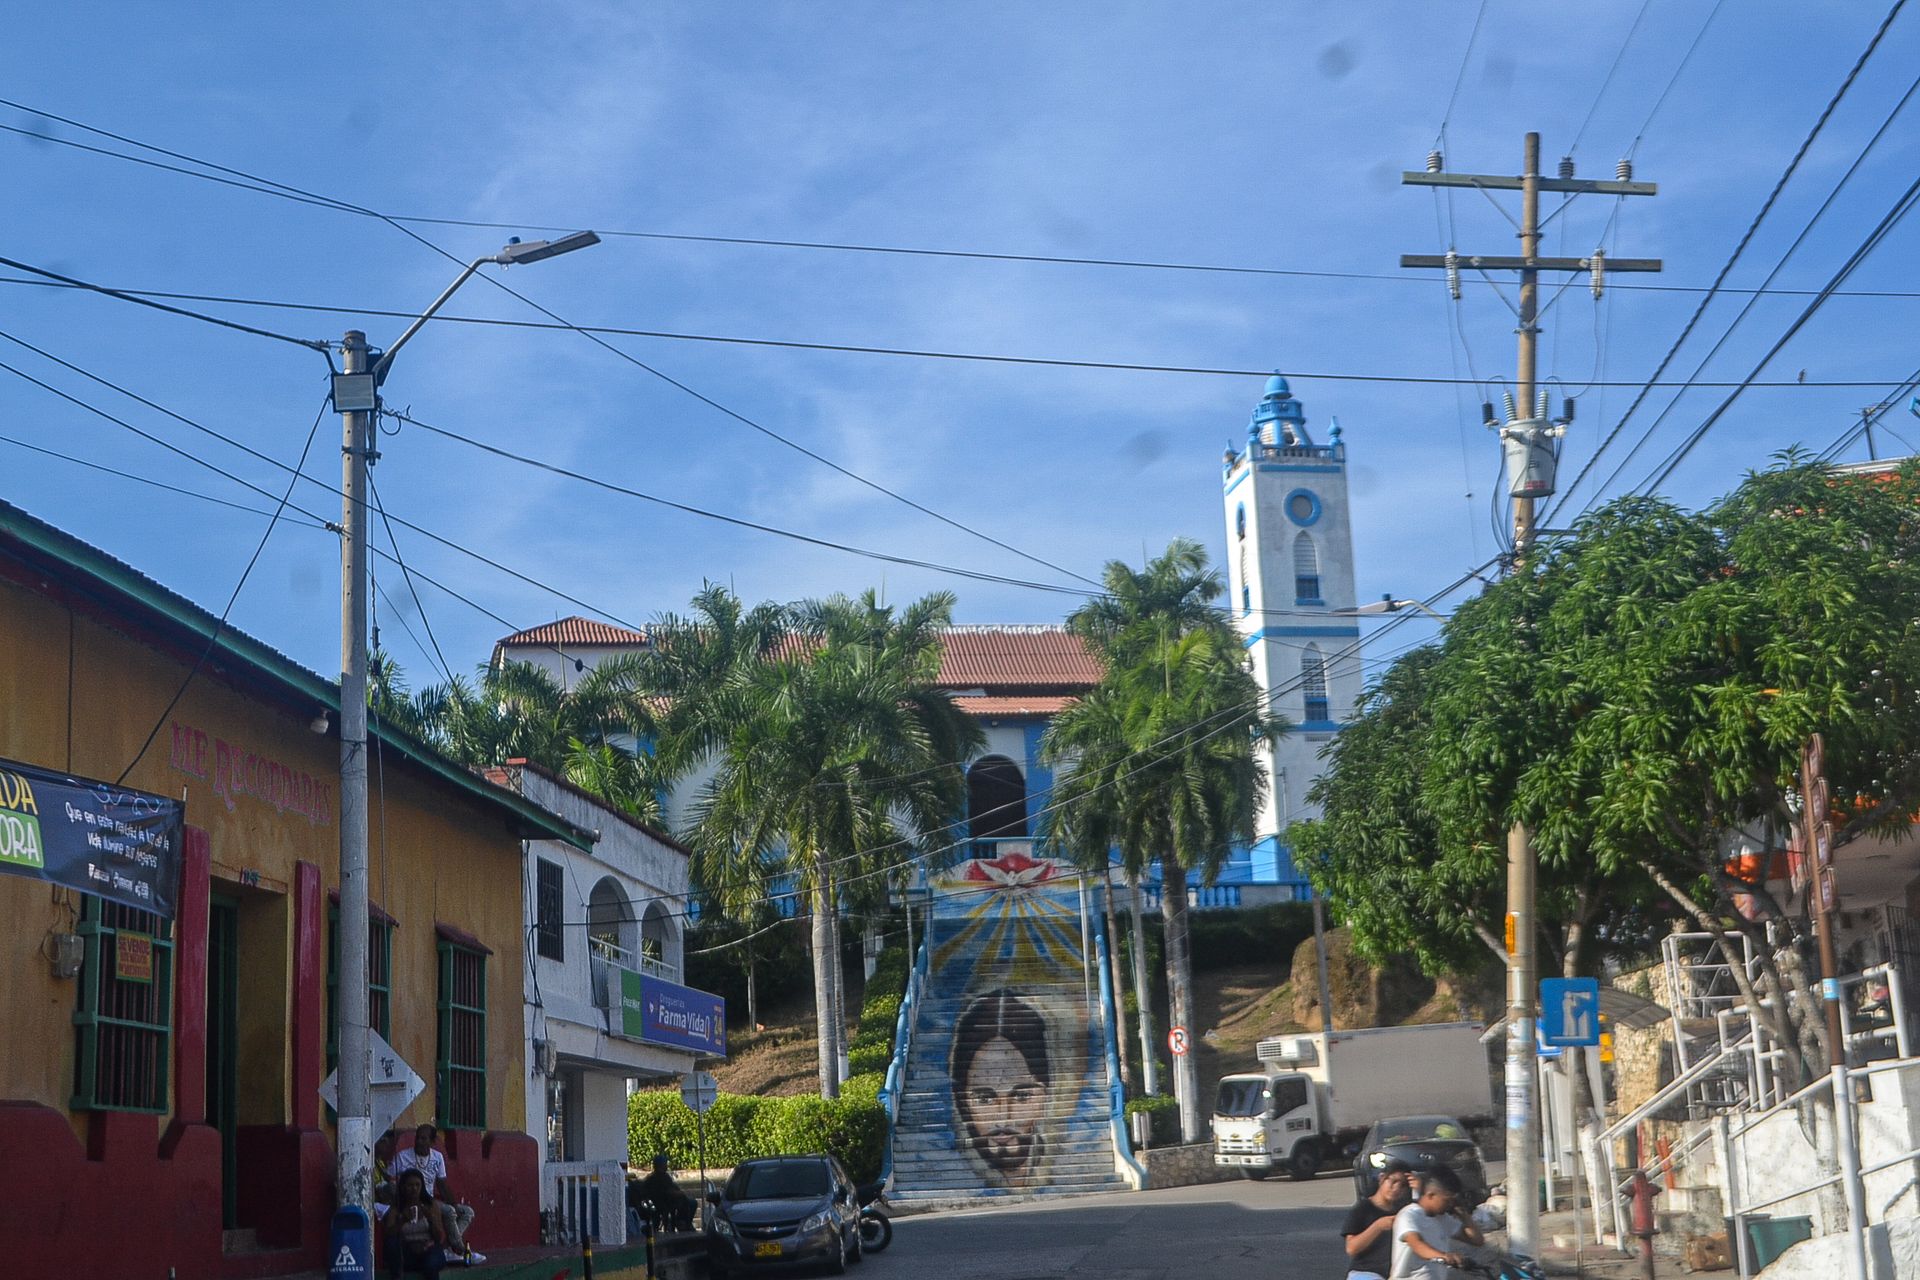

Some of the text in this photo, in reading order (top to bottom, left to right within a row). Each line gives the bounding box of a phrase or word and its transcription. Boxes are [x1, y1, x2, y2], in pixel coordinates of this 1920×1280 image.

[171, 720, 209, 781] ME
[65, 801, 83, 823] Que
[84, 811, 97, 825] en
